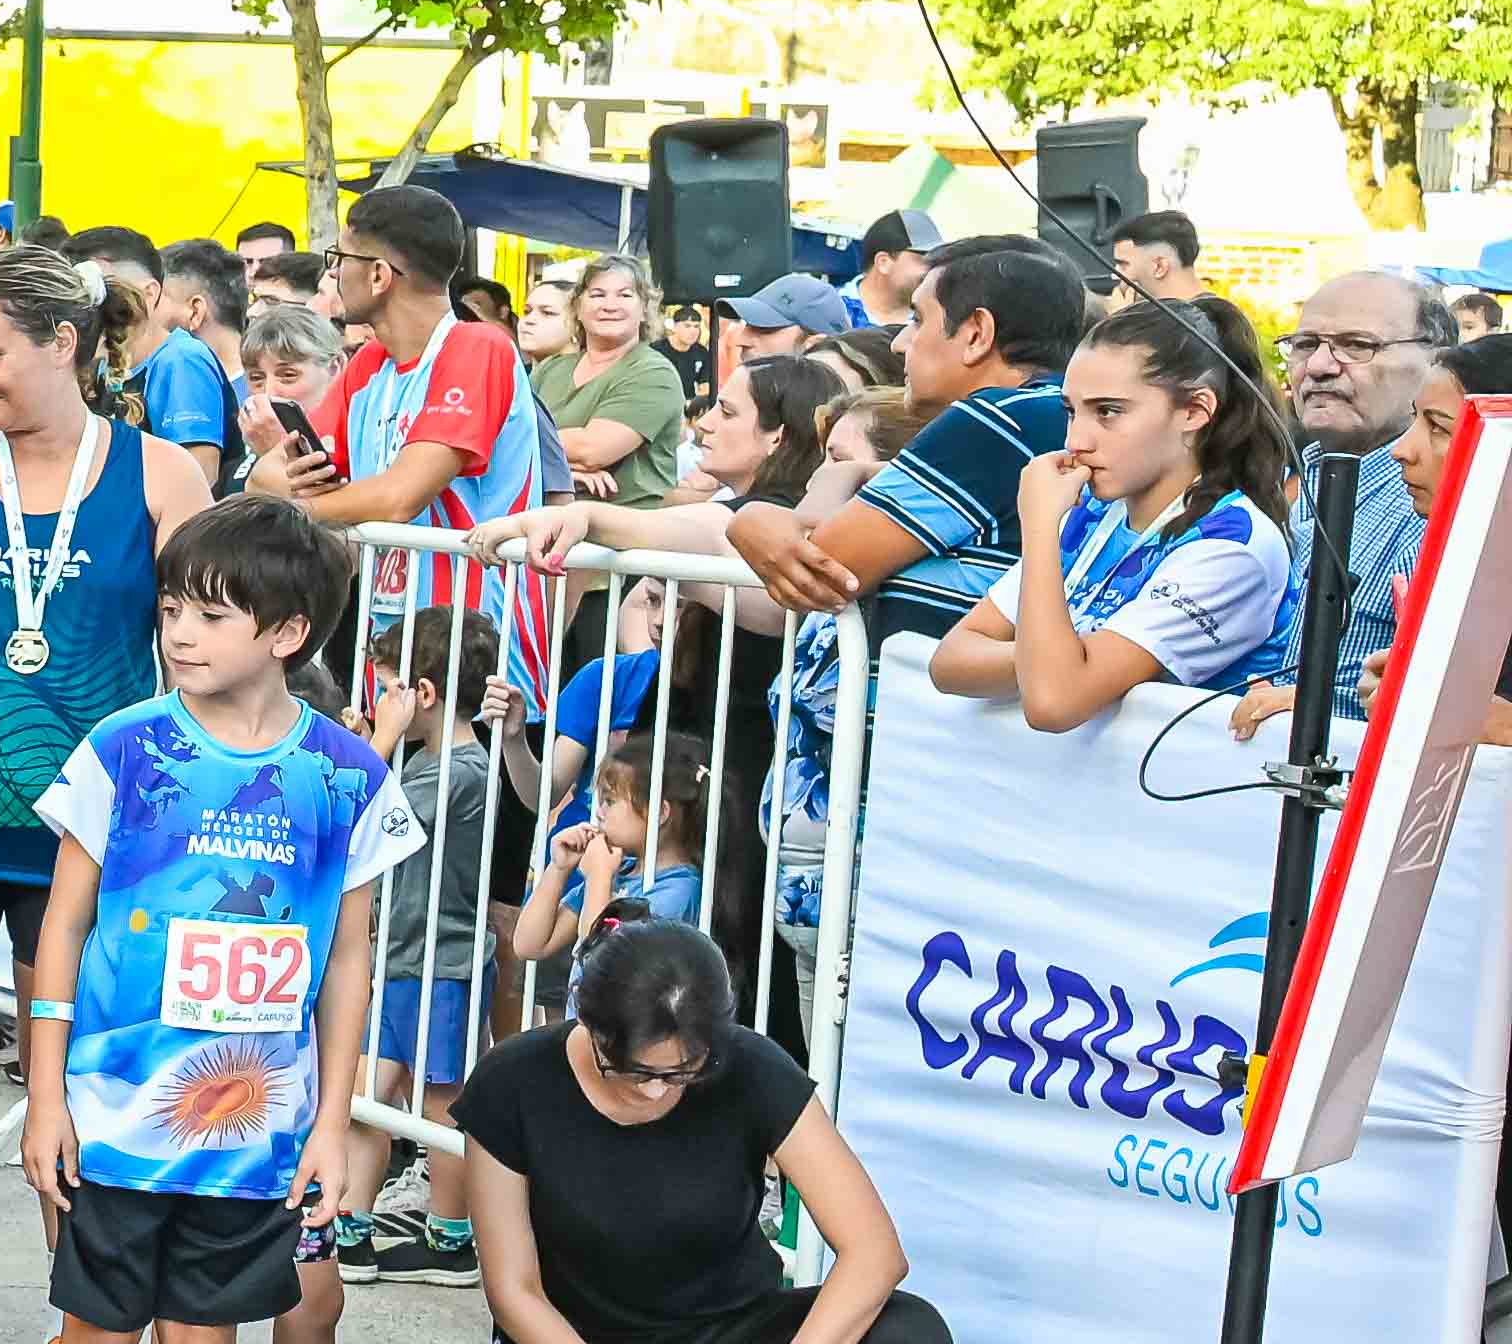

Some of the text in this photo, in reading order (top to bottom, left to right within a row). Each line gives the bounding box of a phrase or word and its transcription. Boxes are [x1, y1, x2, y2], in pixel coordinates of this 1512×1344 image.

[186, 834, 296, 866] MALVINAS
[202, 808, 292, 830] MARATÓN
[178, 933, 303, 1004] 562
[906, 931, 1249, 1135] CARUS
[1107, 1133, 1324, 1238] SEGUS
